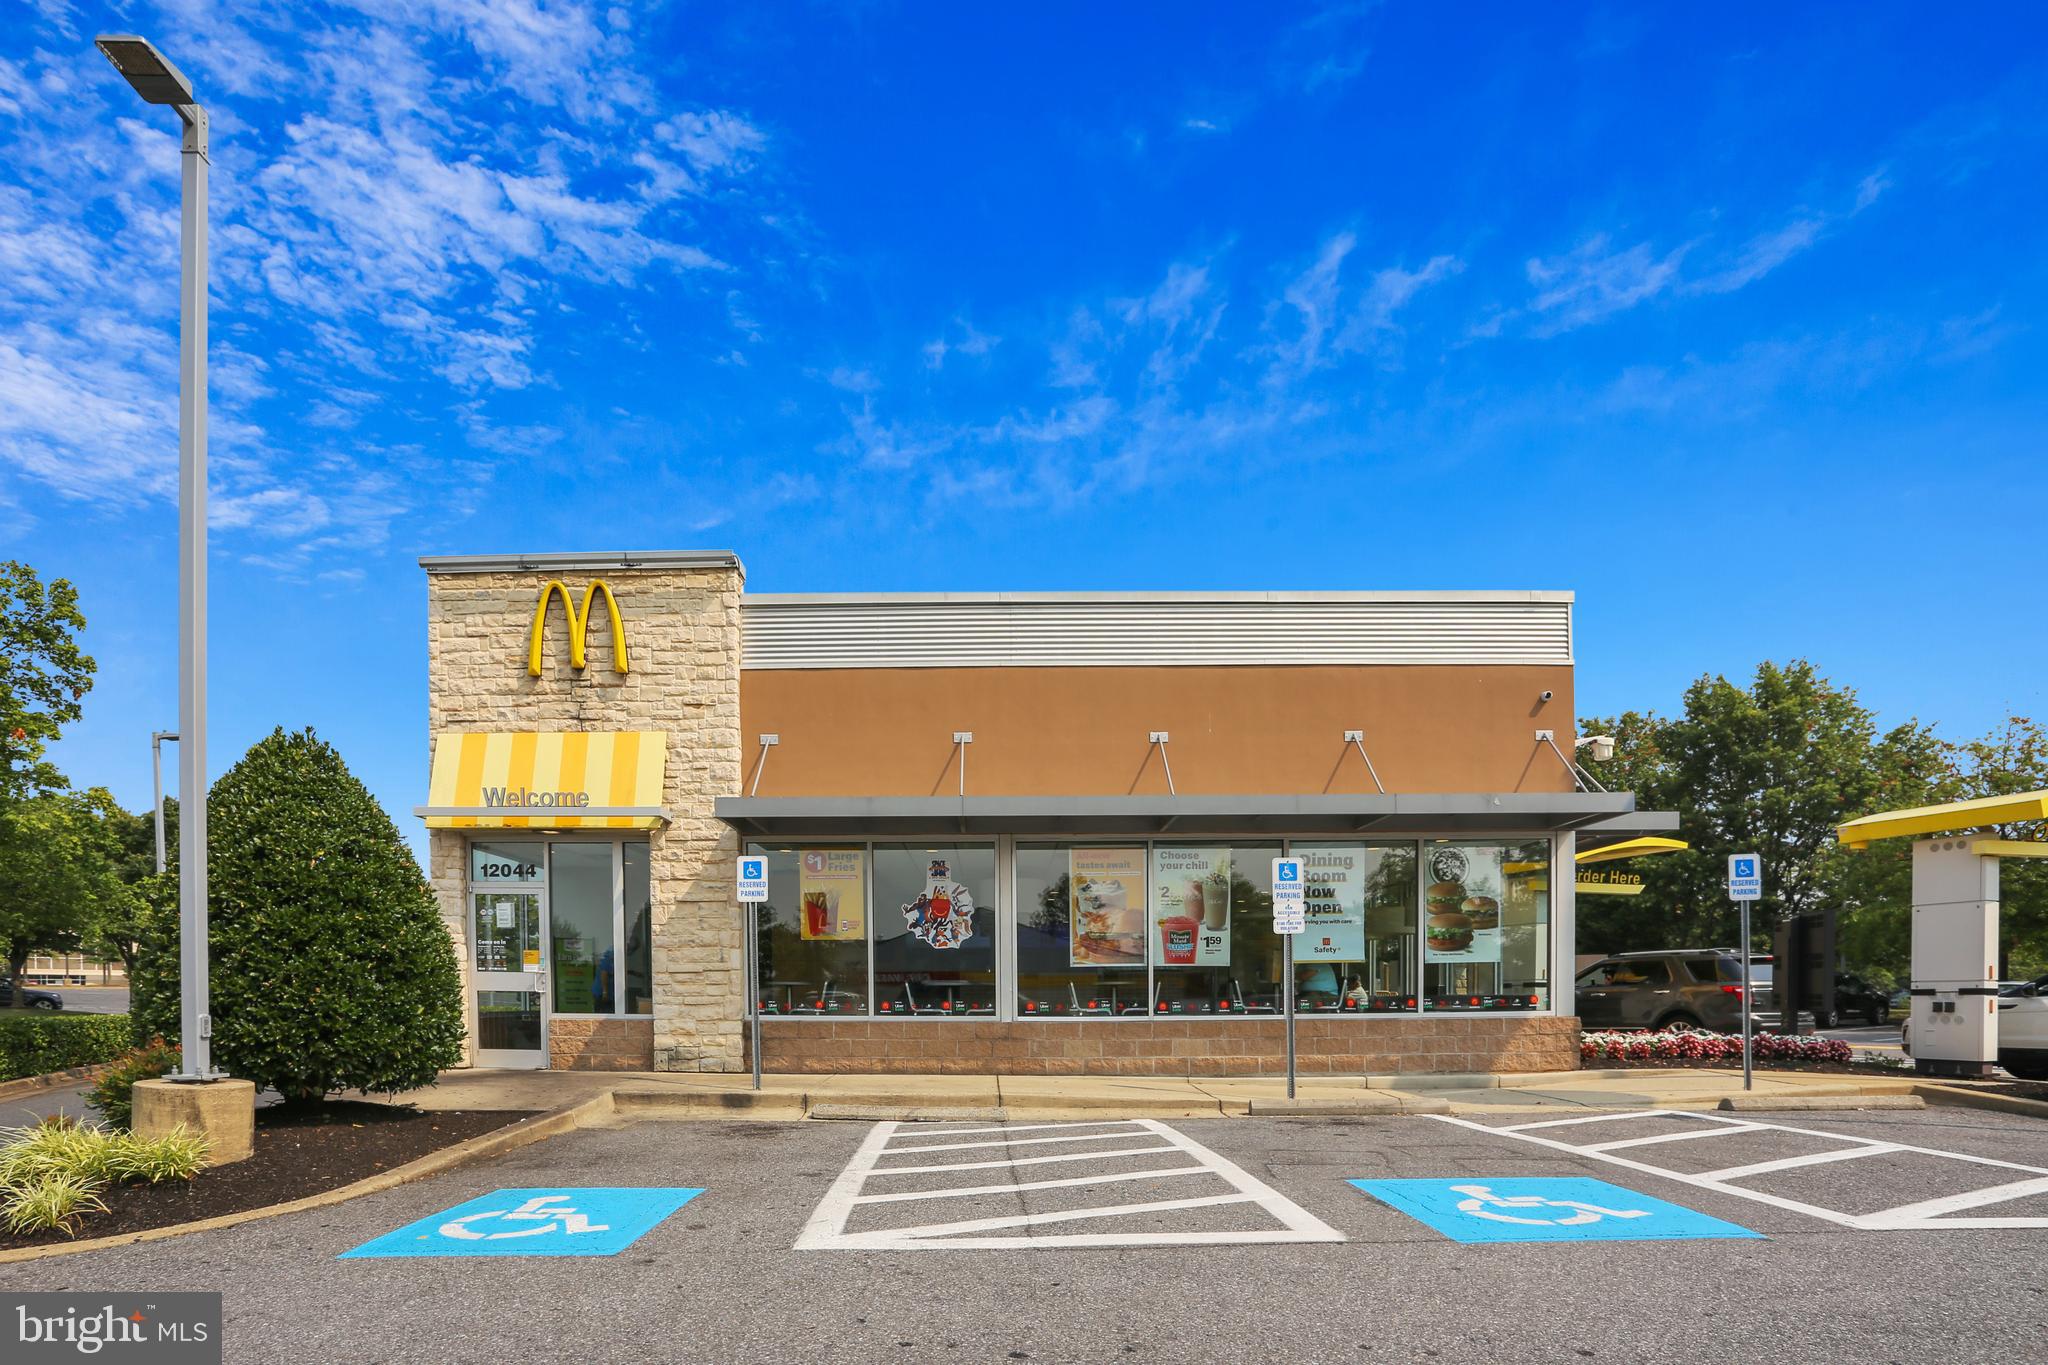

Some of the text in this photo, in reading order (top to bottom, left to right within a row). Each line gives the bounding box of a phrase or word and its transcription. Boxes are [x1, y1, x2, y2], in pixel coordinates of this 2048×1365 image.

[482, 787, 590, 807] Welcome
[828, 852, 859, 863] Large
[1160, 851, 1200, 860] Choose
[1300, 853, 1353, 869] Dining
[808, 855, 822, 870] $1
[828, 862, 855, 871] Fries
[1160, 861, 1208, 872] your chill
[481, 864, 536, 877] 12044
[1576, 869, 1640, 884] rder Here
